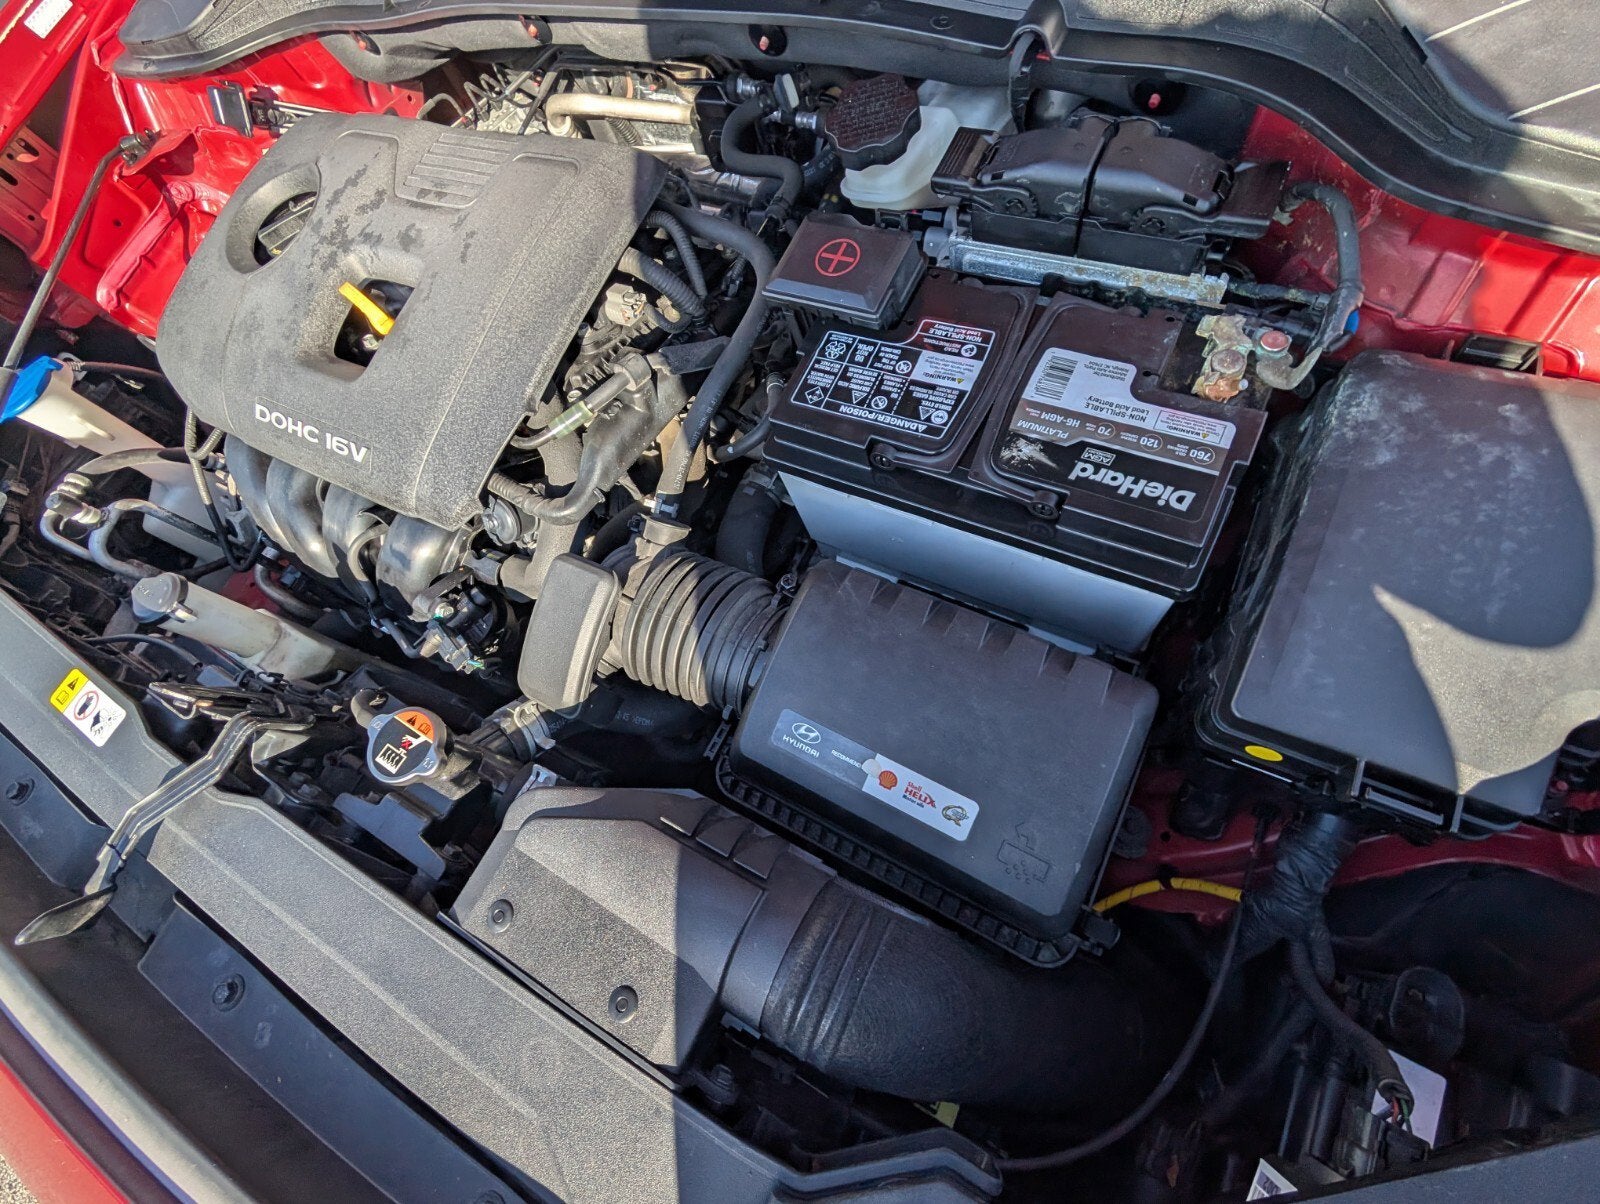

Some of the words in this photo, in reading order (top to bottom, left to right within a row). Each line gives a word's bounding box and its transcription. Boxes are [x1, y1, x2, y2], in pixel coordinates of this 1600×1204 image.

[933, 323, 953, 331] Battery
[928, 328, 982, 342] NON-SPILLABLE
[922, 371, 956, 382] WARNING:
[928, 395, 954, 405] EXPLOSIVE
[1087, 395, 1114, 407] Battery
[1084, 402, 1146, 422] NON-SPILLABLE
[1115, 403, 1130, 411] Acid
[1131, 406, 1149, 415] Lead
[838, 404, 917, 429] DANGER/POISON
[1040, 411, 1080, 427] H6-AGM
[255, 403, 319, 443] DOHC
[325, 432, 368, 463] 16V
[1016, 419, 1068, 439] PLATINUM
[1097, 425, 1111, 435] 70
[1166, 425, 1200, 436] WARNING:
[1139, 436, 1159, 448] 120
[1083, 452, 1110, 463] AGM
[1189, 448, 1211, 461] 760
[1067, 460, 1196, 511] DieHard
[783, 734, 820, 757] HYUNDAI
[908, 782, 922, 792] Shell
[904, 787, 936, 808] HELIX
